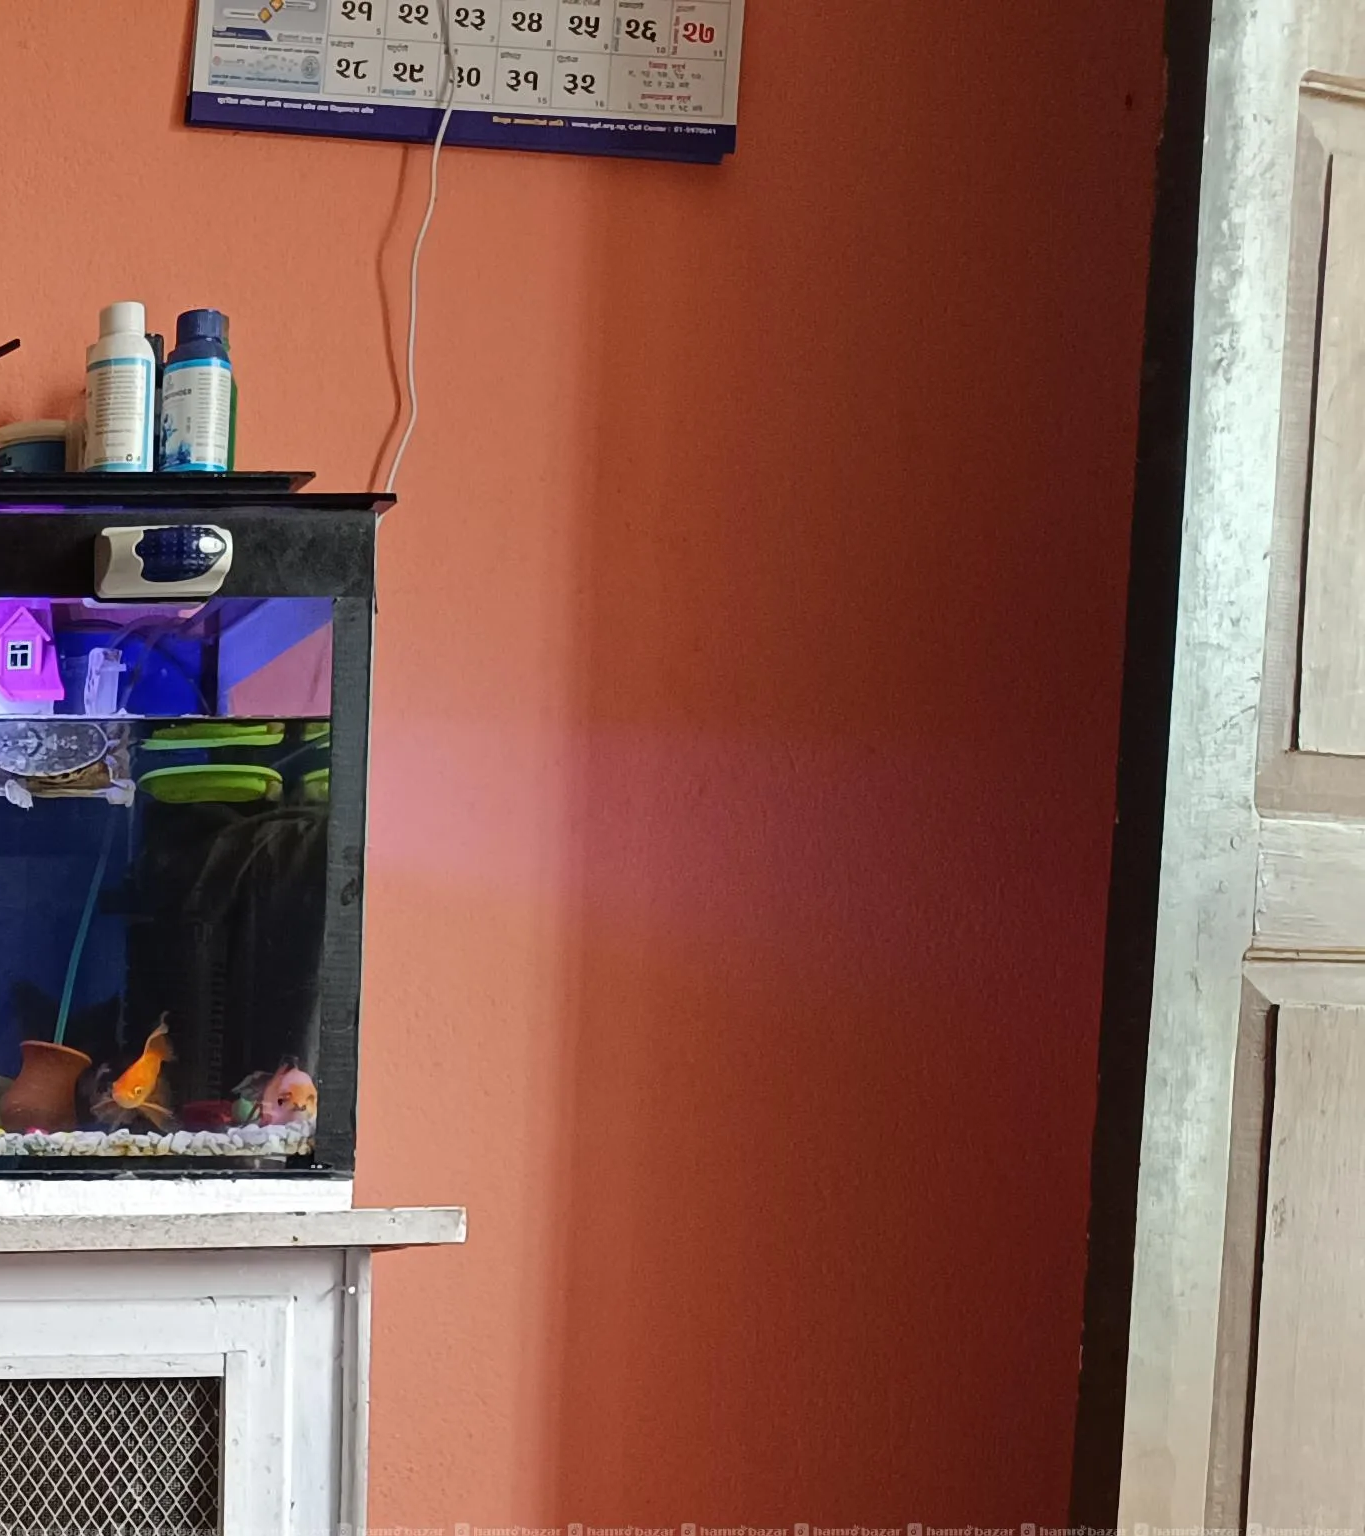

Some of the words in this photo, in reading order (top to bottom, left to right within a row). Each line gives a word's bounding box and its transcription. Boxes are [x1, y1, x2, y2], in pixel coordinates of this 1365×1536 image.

[341, 1, 373, 22] २१
[398, 4, 429, 25] २२
[454, 8, 486, 31] २३
[511, 11, 543, 33] २४
[568, 15, 601, 39] २५
[625, 19, 658, 43] २६
[682, 22, 715, 44] २७
[335, 58, 369, 80] २८
[393, 62, 424, 83] २९
[506, 69, 538, 92] ३१
[563, 73, 596, 95] ३२
